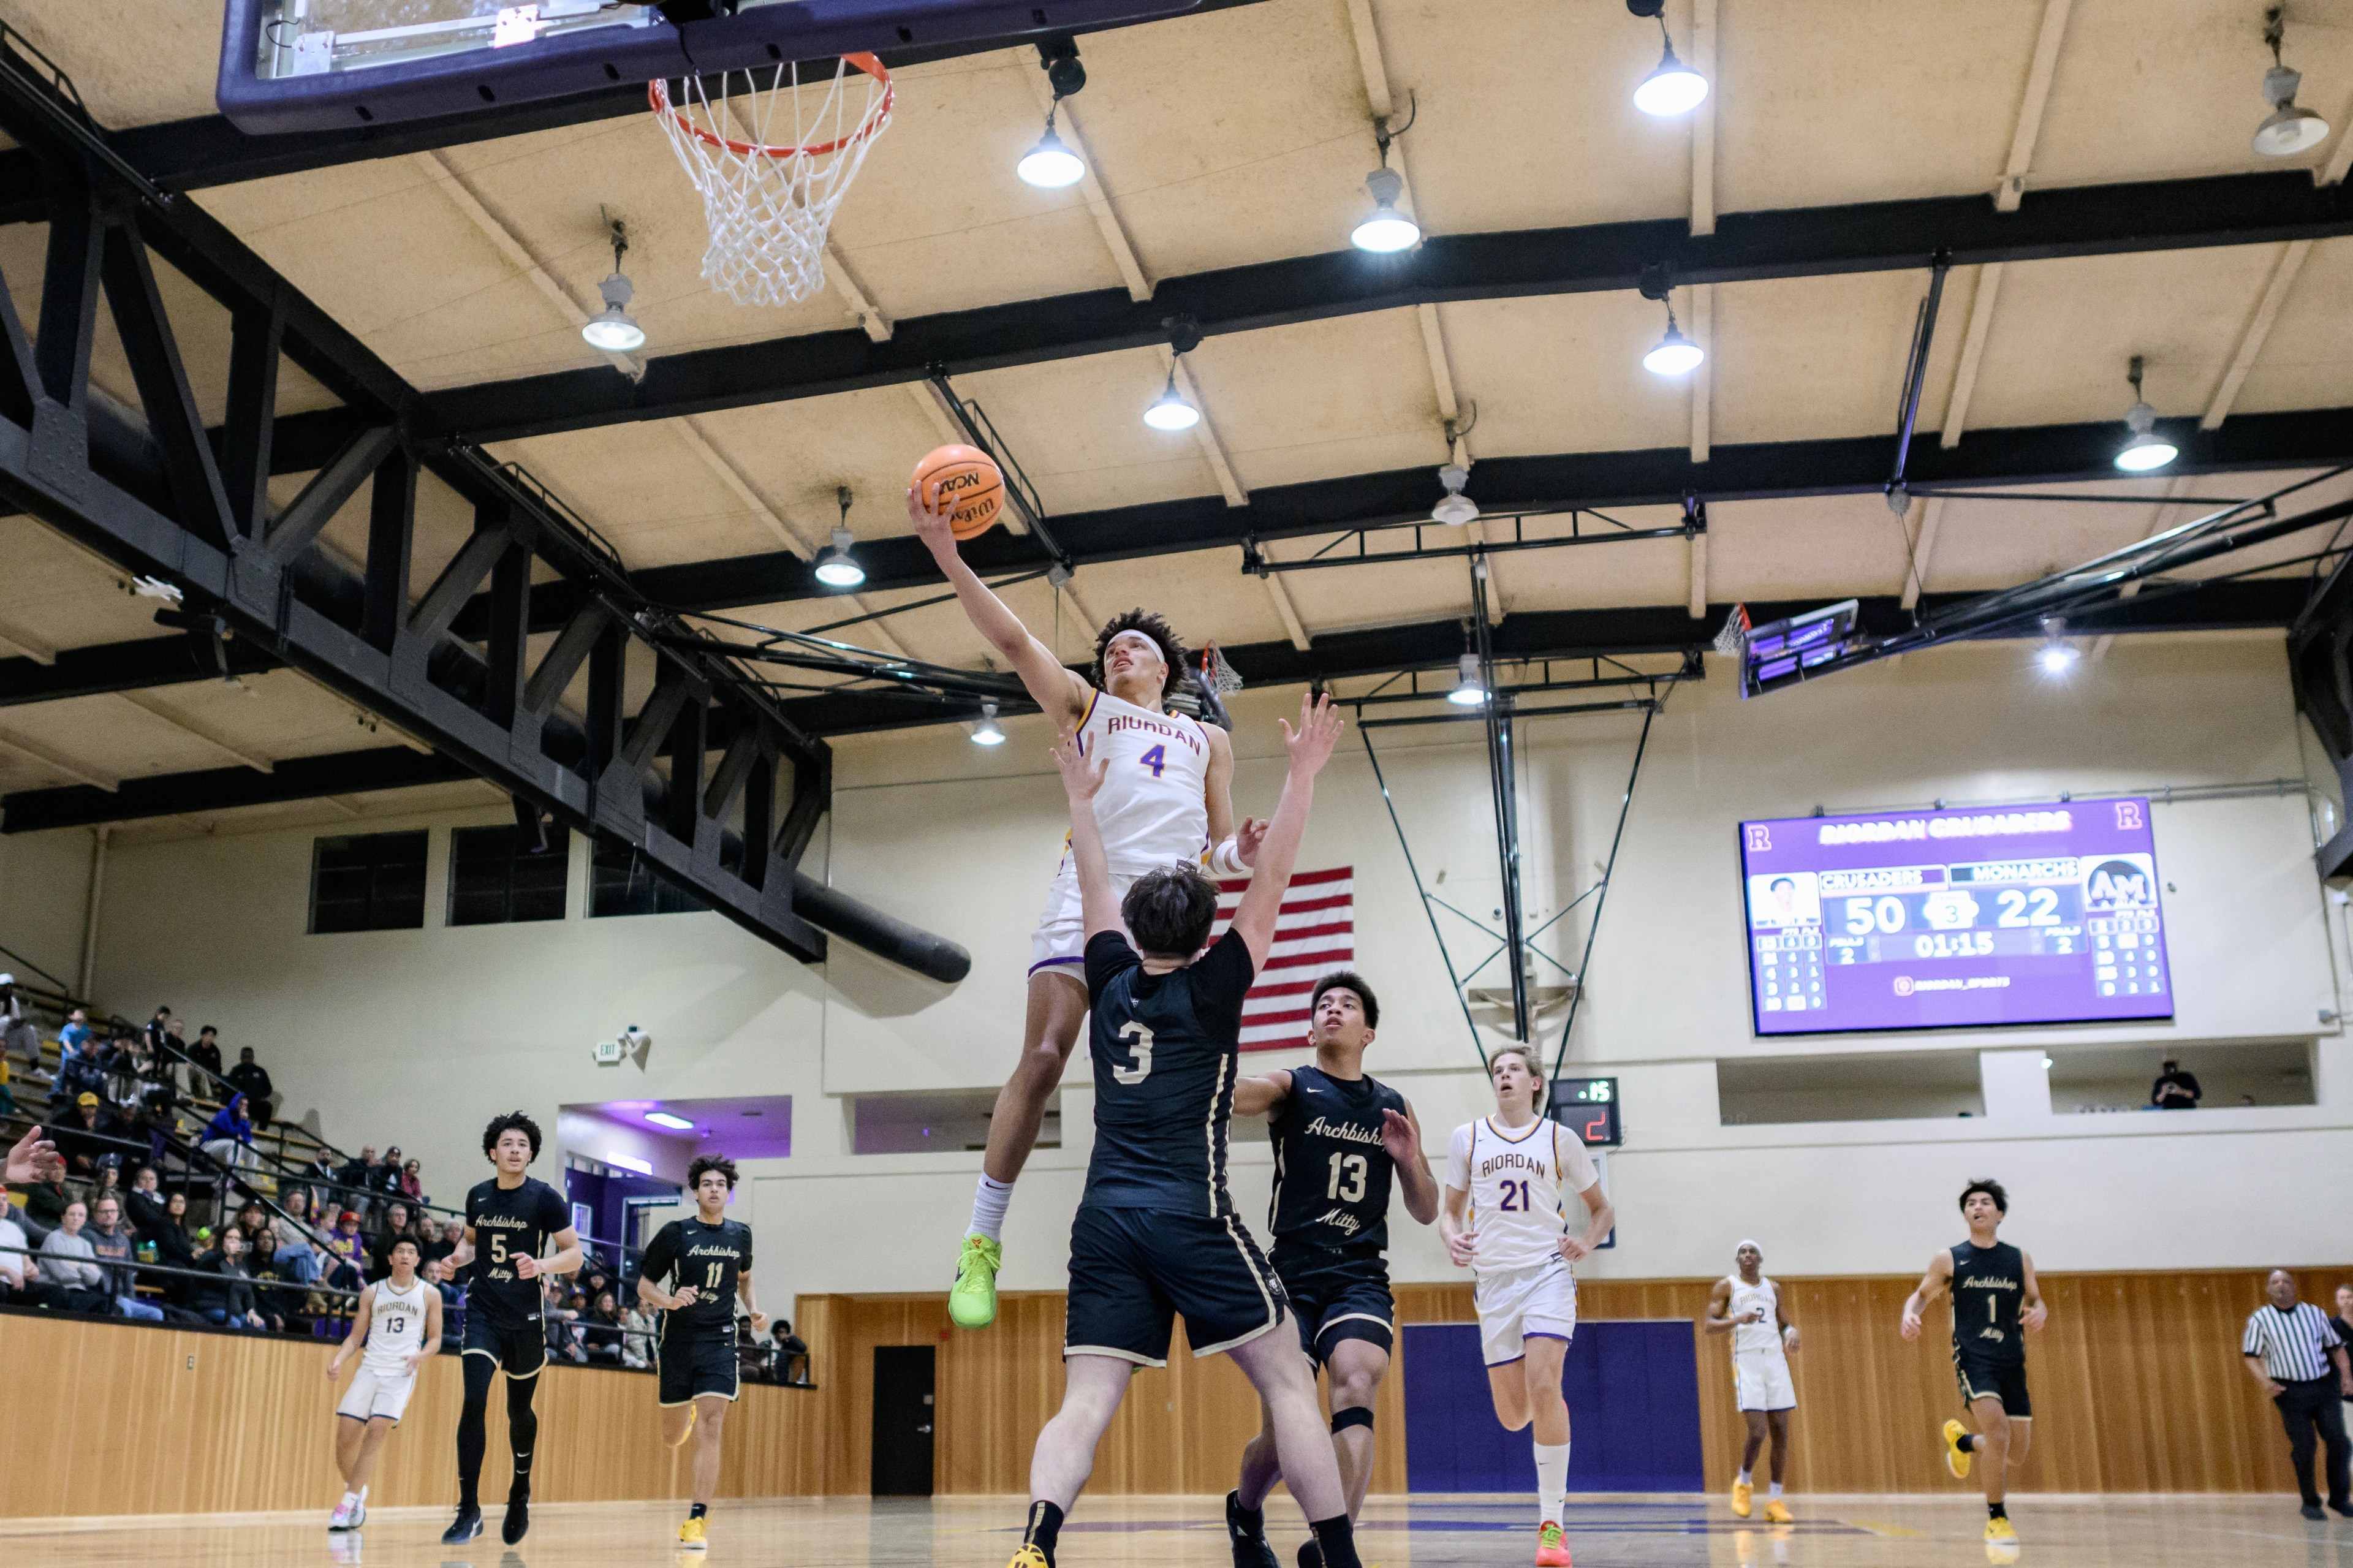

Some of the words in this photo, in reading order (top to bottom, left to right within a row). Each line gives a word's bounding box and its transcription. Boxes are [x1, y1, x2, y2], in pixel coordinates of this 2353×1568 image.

[1108, 715, 1201, 757] RIORDAN
[1139, 743, 1167, 779] 4
[1819, 819, 1927, 845] RIORDAN
[1929, 810, 2073, 838] CRUSADERS
[2115, 801, 2143, 830] R
[1748, 825, 1772, 851] R
[1822, 870, 1923, 890] CRUSADERS
[1974, 860, 2077, 881] MONARCHS
[1846, 896, 1906, 935] 50
[1944, 905, 1958, 923] 3
[1997, 888, 2061, 928] 22
[1840, 947, 1856, 964] 2
[1915, 931, 1995, 958] 01:15
[2058, 937, 2073, 955] 2
[600, 1043, 615, 1056] EXIT
[1113, 1020, 1154, 1085] 3
[1305, 1116, 1387, 1152] Archbisho
[1327, 1151, 1368, 1203] 13
[1482, 1154, 1545, 1179] RIORDAN
[1499, 1180, 1530, 1211] 21
[476, 1214, 528, 1232] Archbishop
[1315, 1208, 1360, 1236] Mitty
[491, 1234, 507, 1263] 5
[687, 1244, 741, 1260] Archbishop
[488, 1267, 513, 1283] Mitty
[705, 1262, 724, 1289] 11
[1961, 1275, 2018, 1292] Archbishop
[377, 1301, 418, 1317] RIORDAN
[1756, 1307, 1767, 1323] 2
[1987, 1294, 1996, 1324] 1
[386, 1317, 404, 1334] 13
